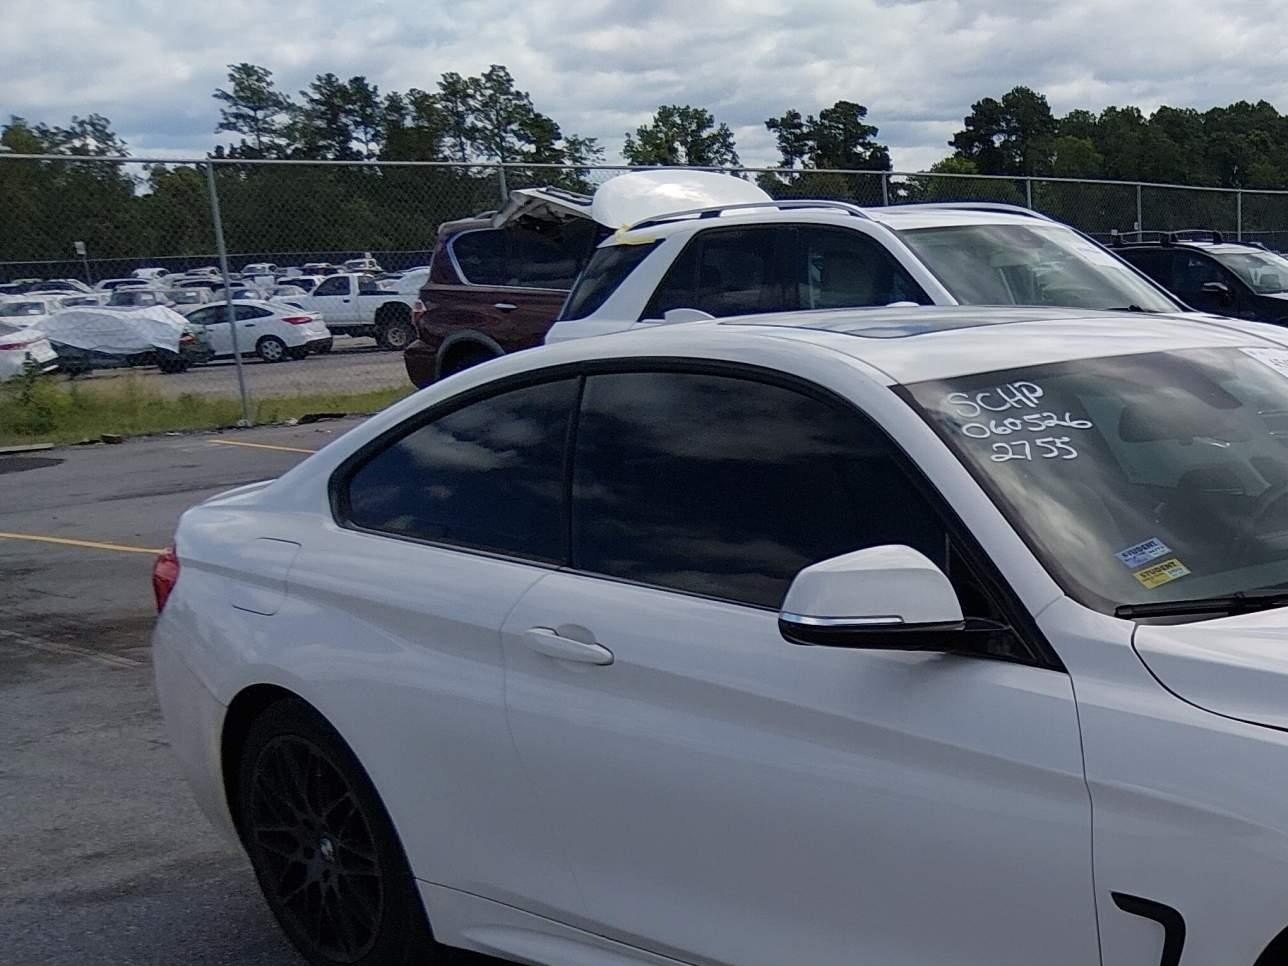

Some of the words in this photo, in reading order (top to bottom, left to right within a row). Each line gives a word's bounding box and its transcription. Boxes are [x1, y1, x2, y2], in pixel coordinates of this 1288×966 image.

[947, 381, 1044, 418] SCHP
[961, 412, 1093, 439] 060526
[990, 436, 1078, 462] 2755
